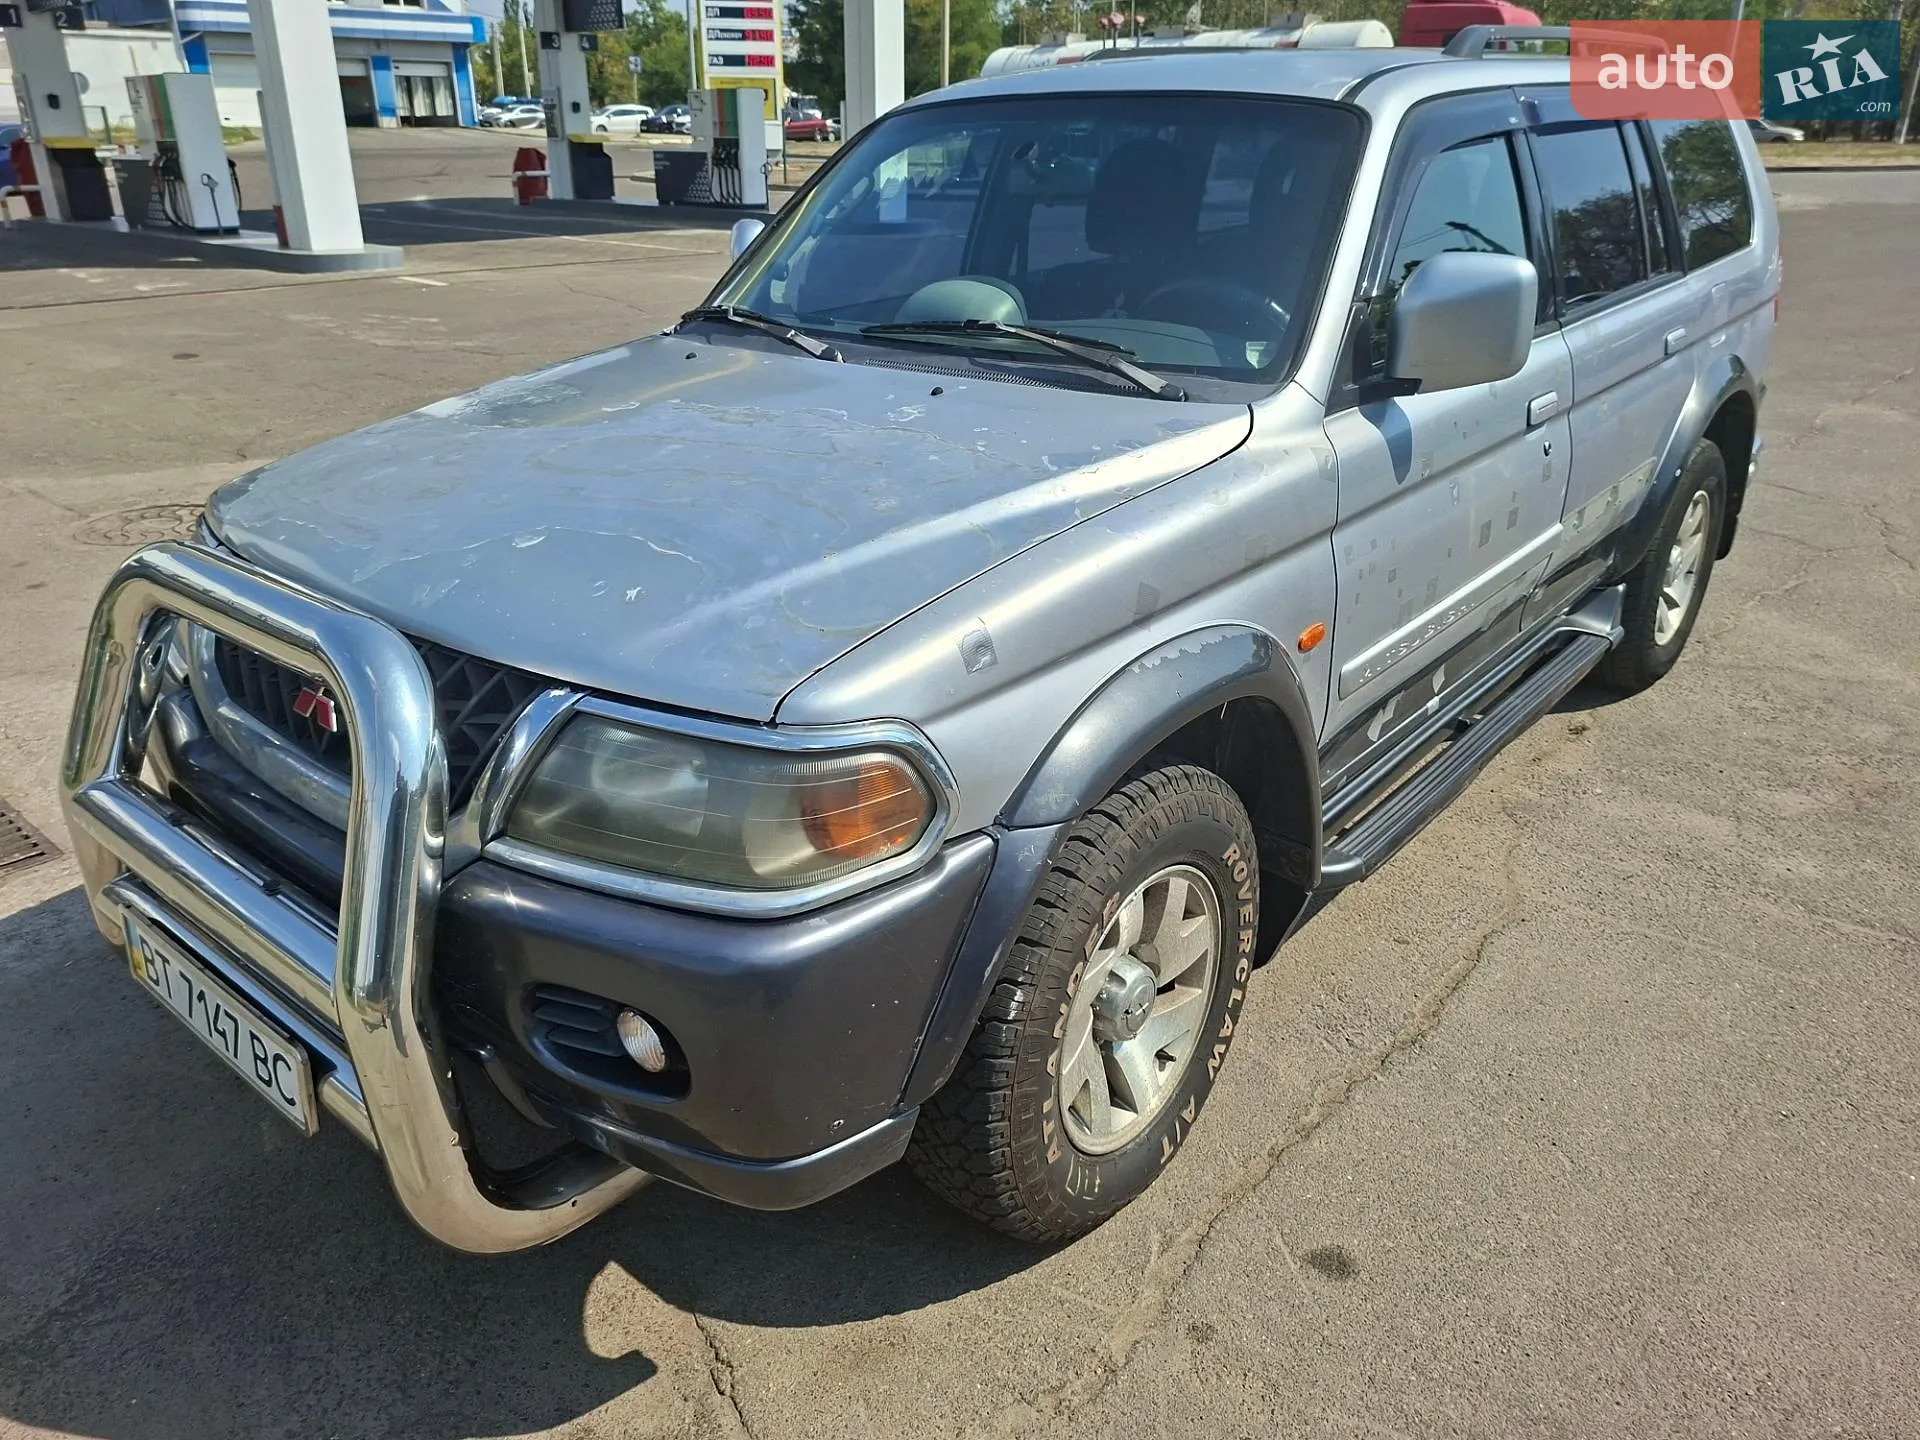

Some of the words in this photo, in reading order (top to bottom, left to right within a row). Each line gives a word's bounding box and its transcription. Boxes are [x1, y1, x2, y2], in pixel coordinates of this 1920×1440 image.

[9, 8, 16, 24] 1
[55, 11, 68, 26] 2
[707, 7, 720, 17] ДП
[551, 34, 559, 48] 3
[581, 36, 589, 49] 4
[709, 56, 724, 65] ГАЗ
[1206, 842, 1254, 1082] ROVERCLAW
[139, 934, 172, 1000] BT
[179, 970, 240, 1060] 7147
[249, 1029, 297, 1107] BC
